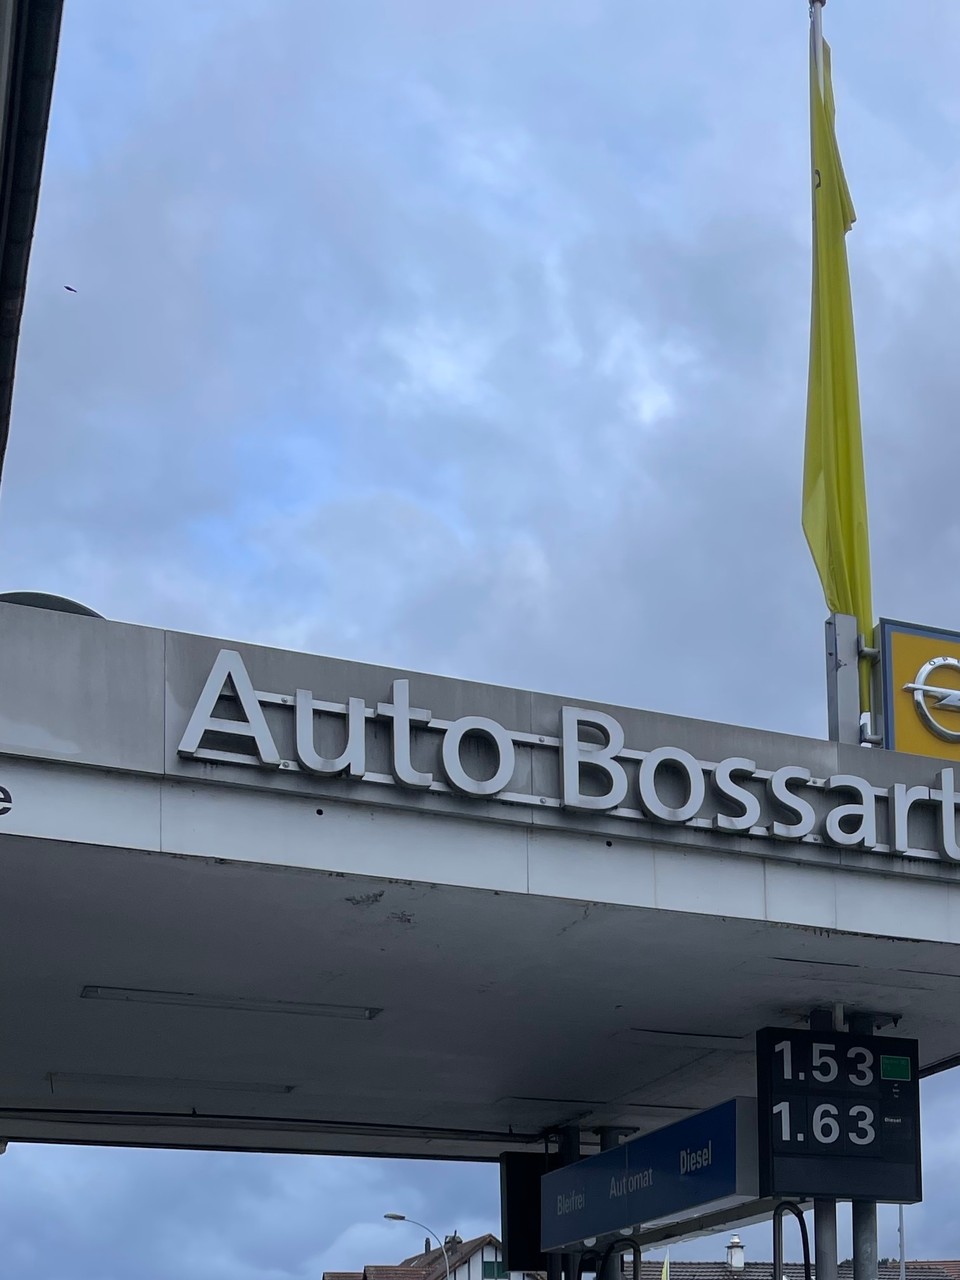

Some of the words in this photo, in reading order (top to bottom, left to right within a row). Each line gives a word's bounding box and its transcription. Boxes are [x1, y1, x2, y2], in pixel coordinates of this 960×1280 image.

[178, 649, 515, 796] Auto
[774, 1040, 874, 1086] 1.53
[772, 1101, 876, 1145] 1.63
[557, 1188, 585, 1215] Bleifrei
[609, 1168, 653, 1199] Automat
[680, 1140, 712, 1175] Diesel
